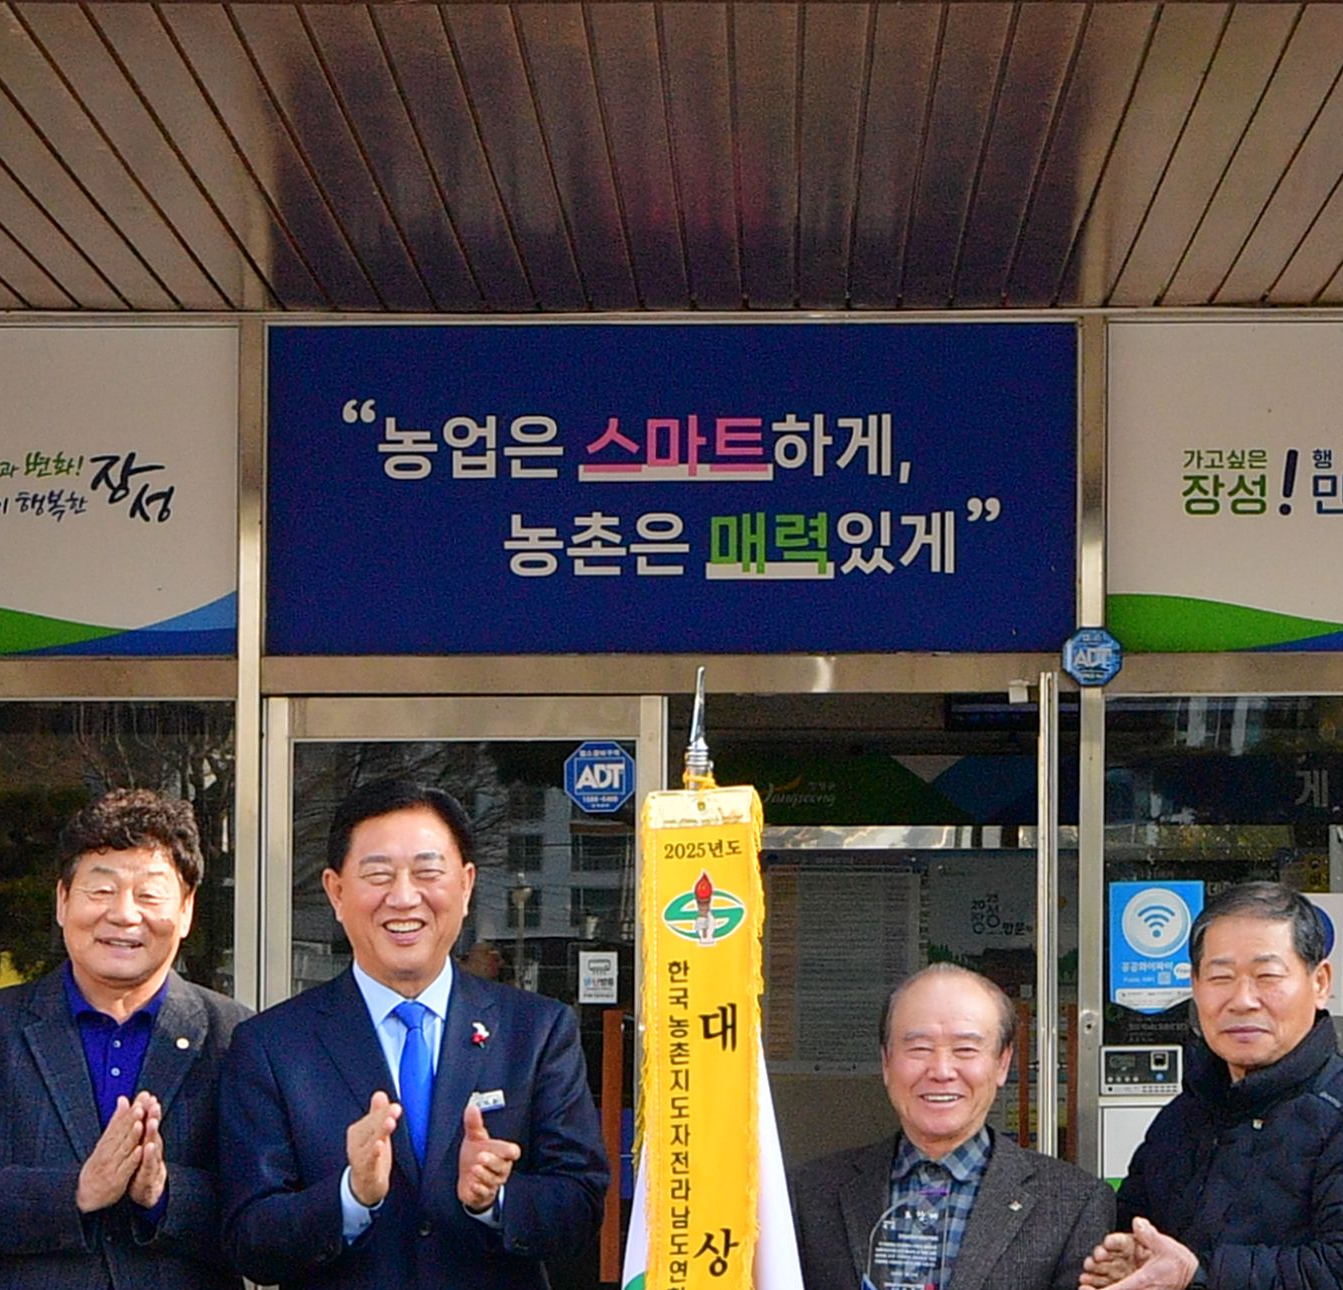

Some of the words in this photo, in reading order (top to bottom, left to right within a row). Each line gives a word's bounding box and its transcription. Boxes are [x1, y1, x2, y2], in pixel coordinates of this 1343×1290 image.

[342, 399, 565, 481] “농업은
[580, 412, 911, 484] 스마트하게,
[24, 451, 84, 478] 변화!
[1183, 449, 1269, 469] 가고싶은
[90, 452, 175, 523] 장성
[15, 489, 88, 522] 행복한
[503, 513, 691, 577] 농촌은
[708, 497, 1001, 575] 매력있게”
[575, 763, 625, 790] ADT
[664, 838, 743, 860] 2025년도
